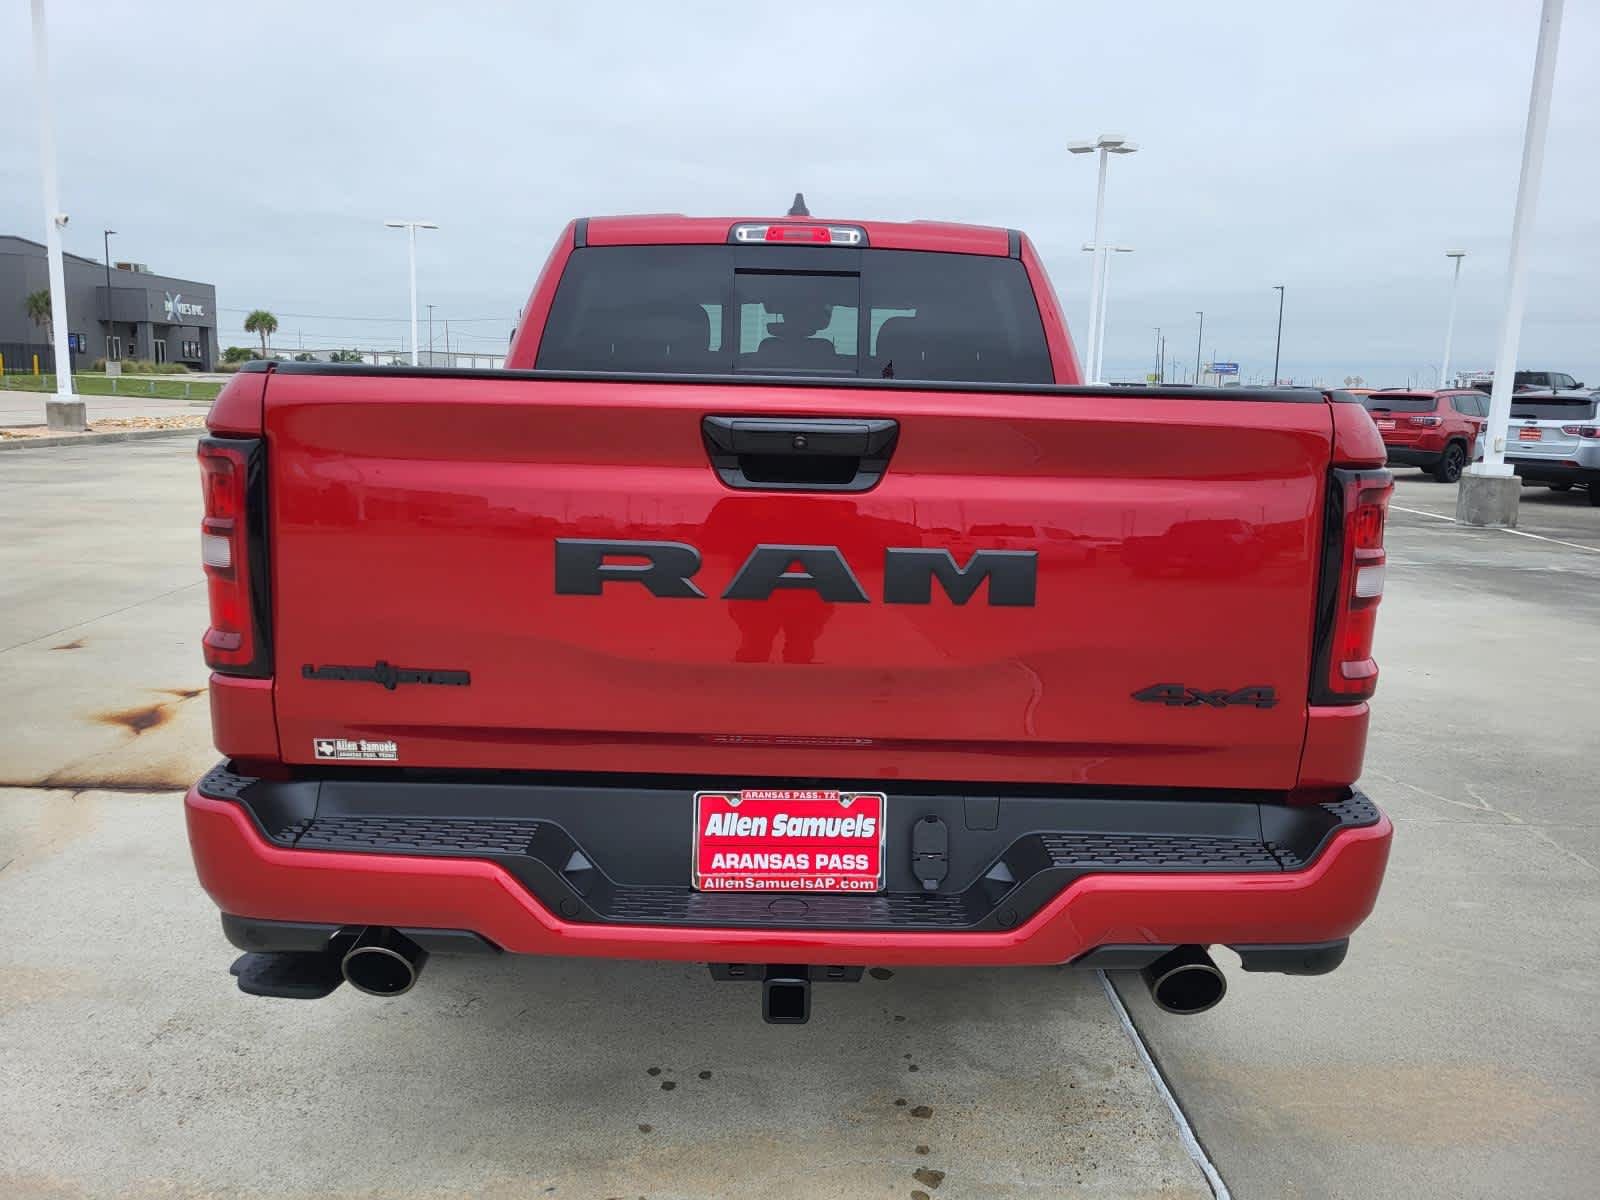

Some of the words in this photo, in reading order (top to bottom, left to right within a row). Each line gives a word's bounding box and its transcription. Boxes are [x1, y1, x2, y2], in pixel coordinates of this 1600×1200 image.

[554, 538, 1038, 607] RAM
[1131, 682, 1278, 709] 4x4
[336, 739, 358, 751] Allen
[360, 740, 397, 752] Samuels
[745, 791, 790, 799] ARANSAS
[824, 792, 836, 800] TX
[704, 813, 768, 837] Allen
[771, 813, 876, 838] Samuels
[711, 853, 810, 870] ARANSAS
[815, 853, 869, 871] PASS
[704, 877, 874, 890] AllenSamuelsAP.com
